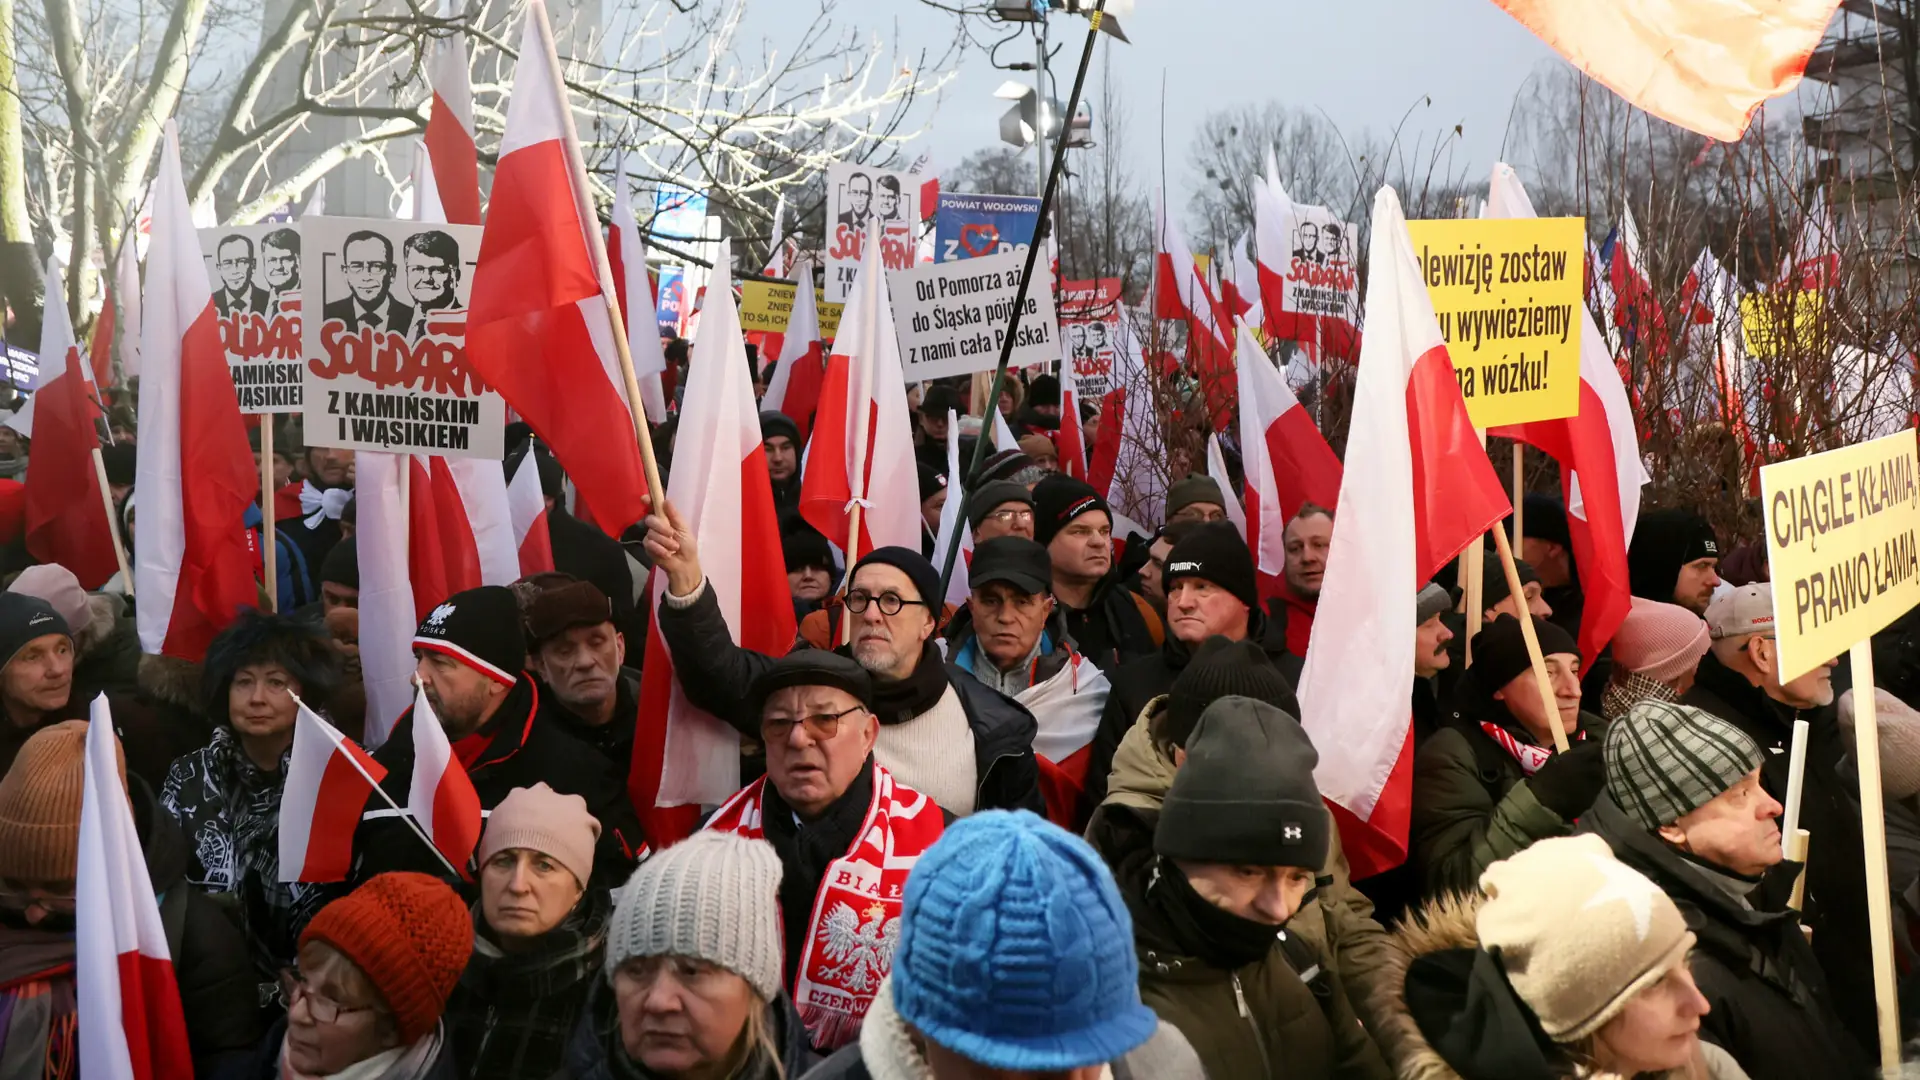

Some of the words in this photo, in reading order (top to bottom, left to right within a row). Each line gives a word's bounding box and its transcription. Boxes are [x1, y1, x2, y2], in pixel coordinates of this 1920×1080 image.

[941, 199, 980, 210] POWIAT
[983, 202, 1038, 213] WOŁOWSKI
[944, 239, 959, 261] Z
[837, 267, 844, 282] Z
[916, 279, 936, 302] Od
[938, 272, 1003, 299] Pomorza
[1006, 264, 1022, 287] aż
[1417, 243, 1493, 295] lewizję
[1500, 244, 1567, 284] zostaw
[662, 287, 672, 299] Z
[743, 312, 755, 321] TO
[757, 314, 769, 326] SĄ
[771, 316, 788, 325] ICH
[912, 311, 930, 333] do
[933, 304, 982, 331] Śląska
[1435, 311, 1451, 344] u
[1457, 297, 1572, 352] wywieziemy
[909, 347, 918, 364] z
[921, 336, 957, 362] nami
[960, 332, 992, 356] cała
[994, 321, 1050, 351] Plska!
[1482, 350, 1549, 396] wózku!
[328, 391, 340, 415] Z
[345, 392, 479, 425] KAMIŃSKIM
[339, 418, 346, 441] I
[351, 418, 469, 450] WĄSIKIEM
[1772, 471, 1855, 553] CIĄGLE
[1170, 561, 1192, 572] PUMA
[1795, 551, 1871, 636] PRAWO
[1873, 528, 1920, 596] ŁAMIĄ
[834, 869, 904, 898] BIAŁ
[808, 988, 869, 1013] CZERW
